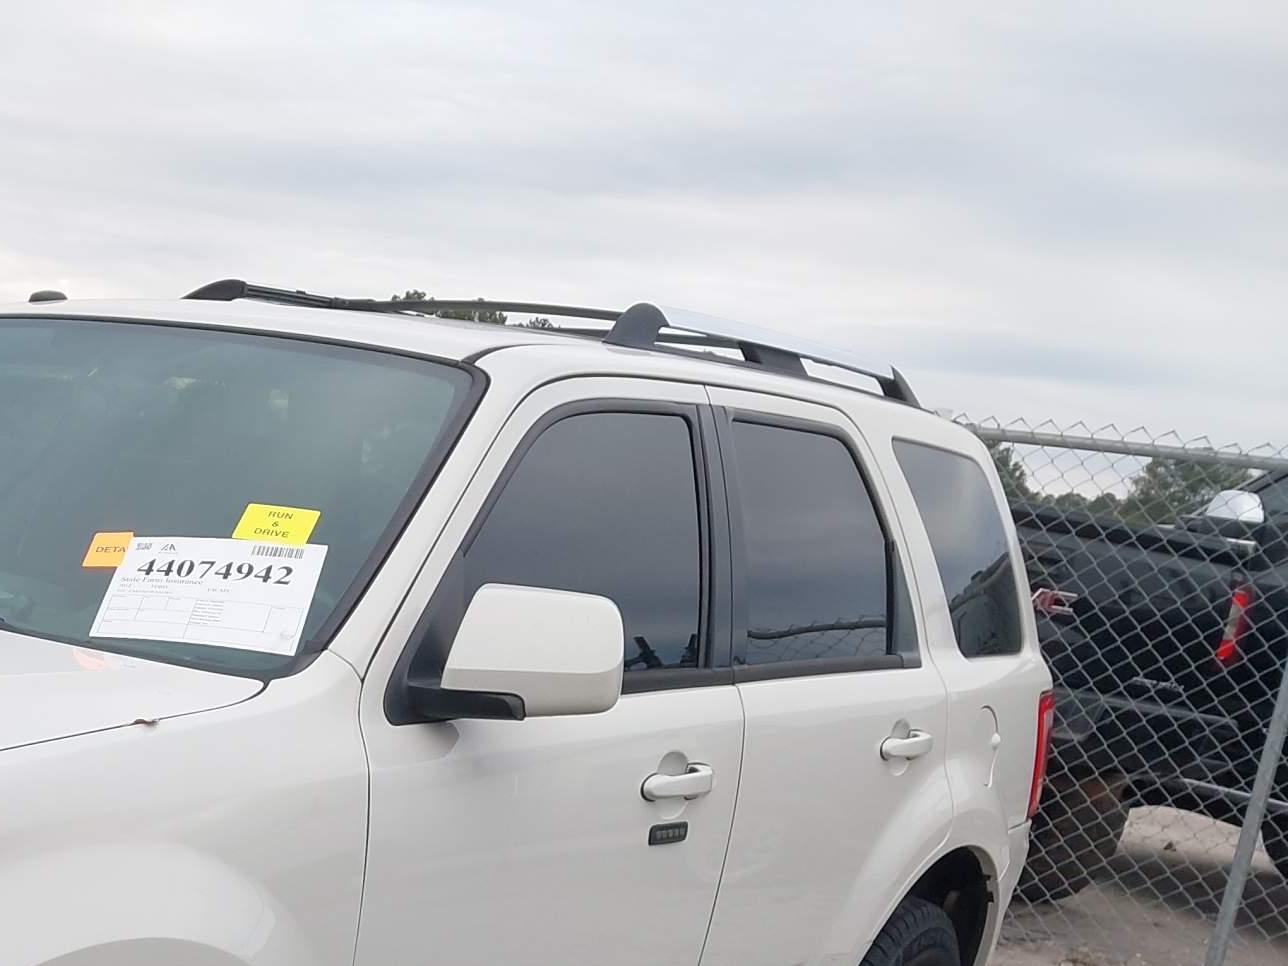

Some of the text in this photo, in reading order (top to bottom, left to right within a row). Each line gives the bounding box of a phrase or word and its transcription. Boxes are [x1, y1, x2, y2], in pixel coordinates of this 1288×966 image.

[267, 511, 294, 520] RUN
[253, 528, 290, 538] DRIVE
[95, 545, 129, 553] DETA
[137, 558, 294, 585] 44074942
